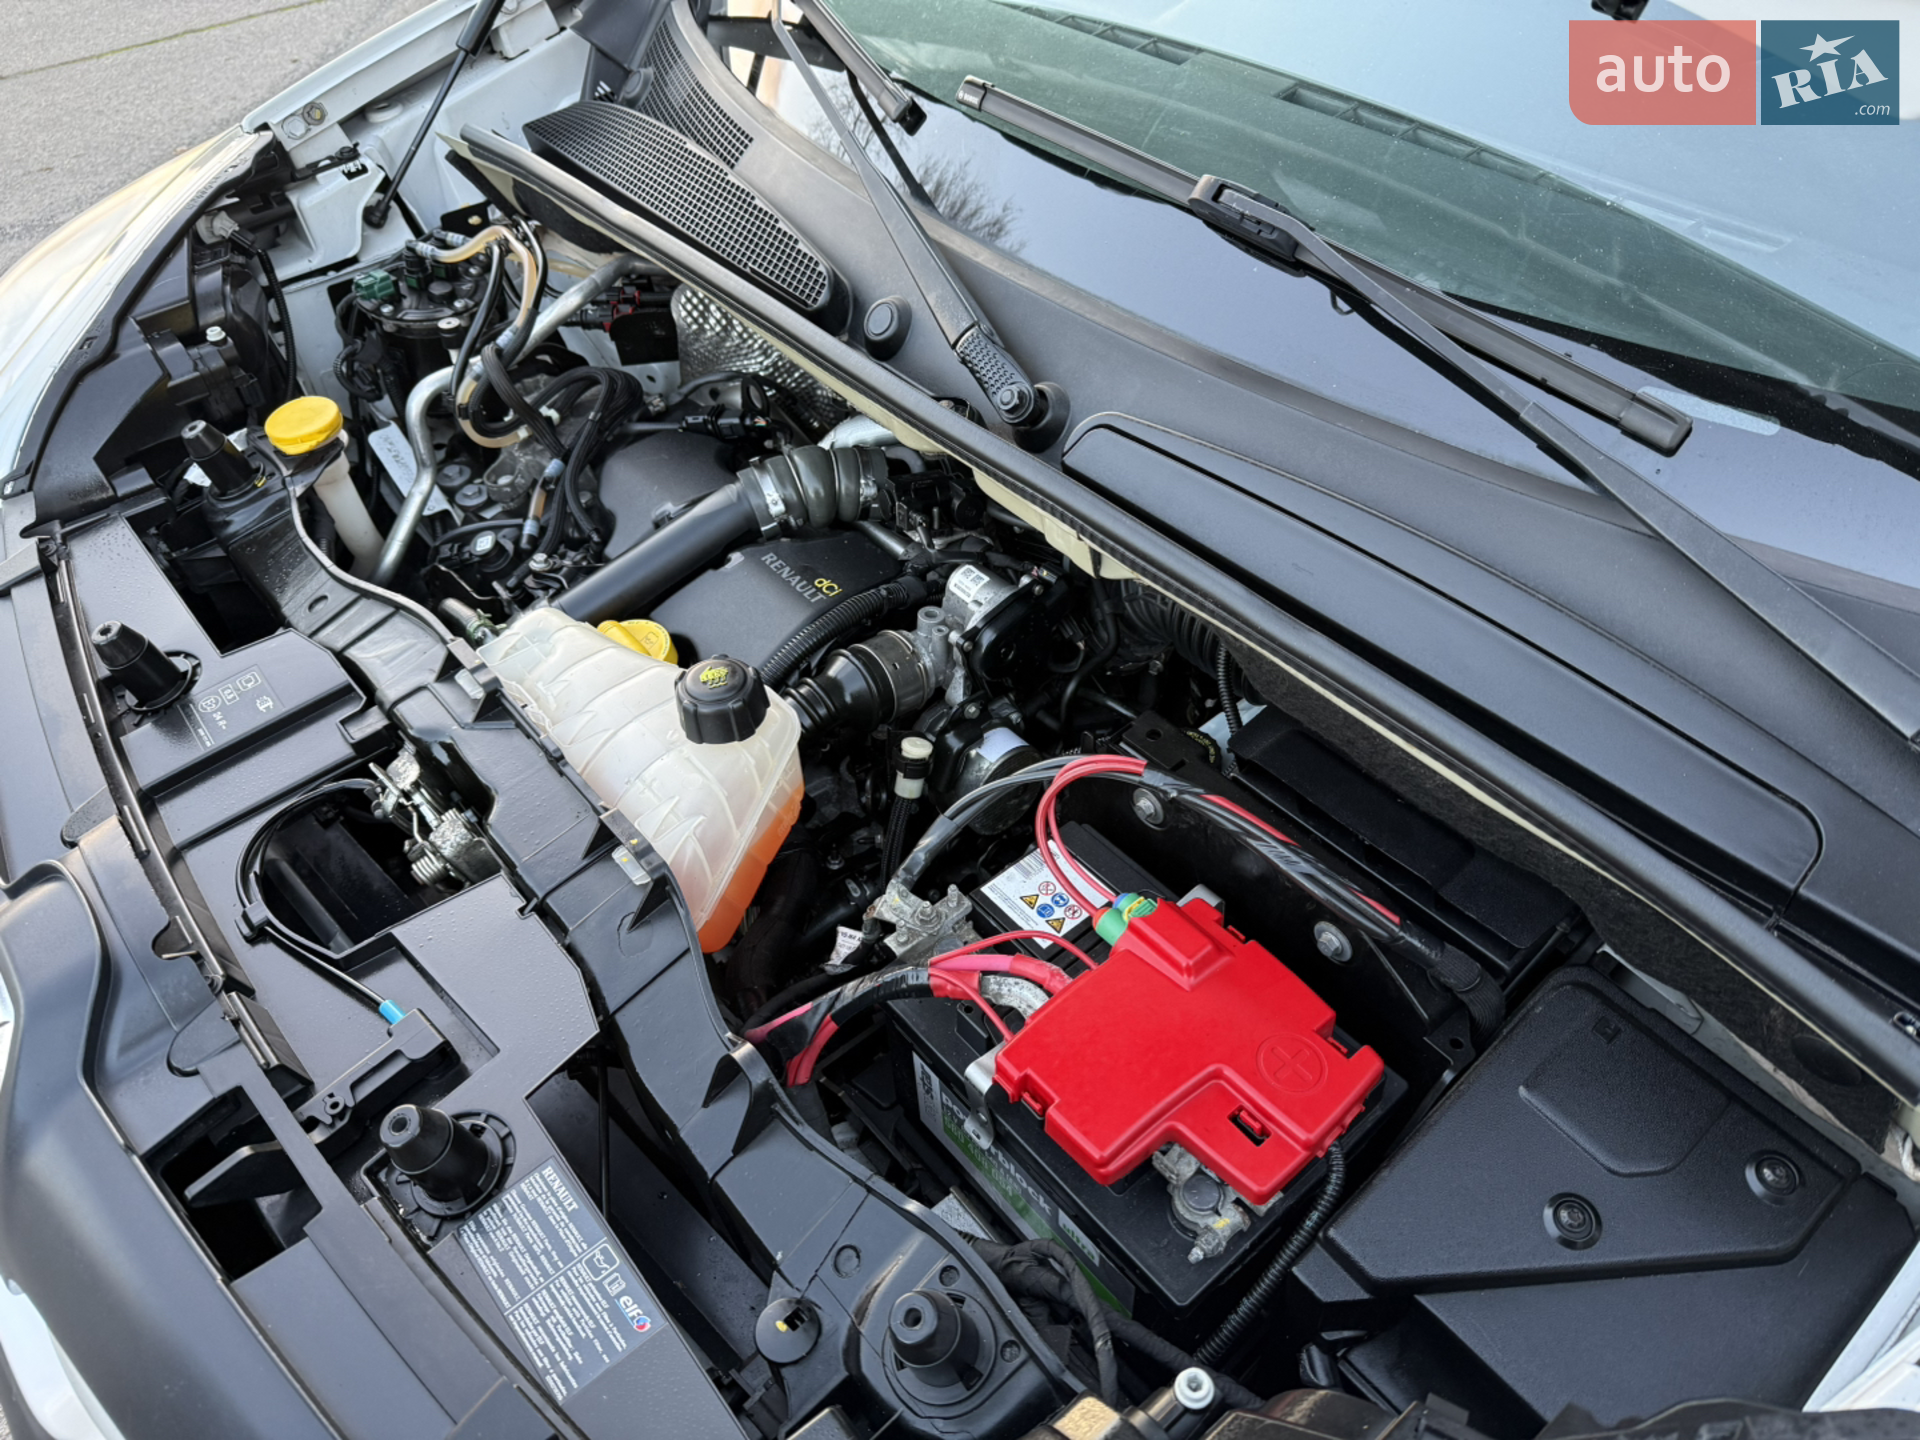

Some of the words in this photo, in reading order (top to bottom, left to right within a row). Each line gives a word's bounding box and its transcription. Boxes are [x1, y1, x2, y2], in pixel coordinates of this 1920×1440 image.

[760, 552, 826, 603] RENAULT
[814, 578, 842, 597] dCi
[941, 1091, 1052, 1216] porblock
[541, 1166, 579, 1212] RENAULT
[1062, 1222, 1095, 1260] ultra
[620, 1295, 643, 1320] elf
